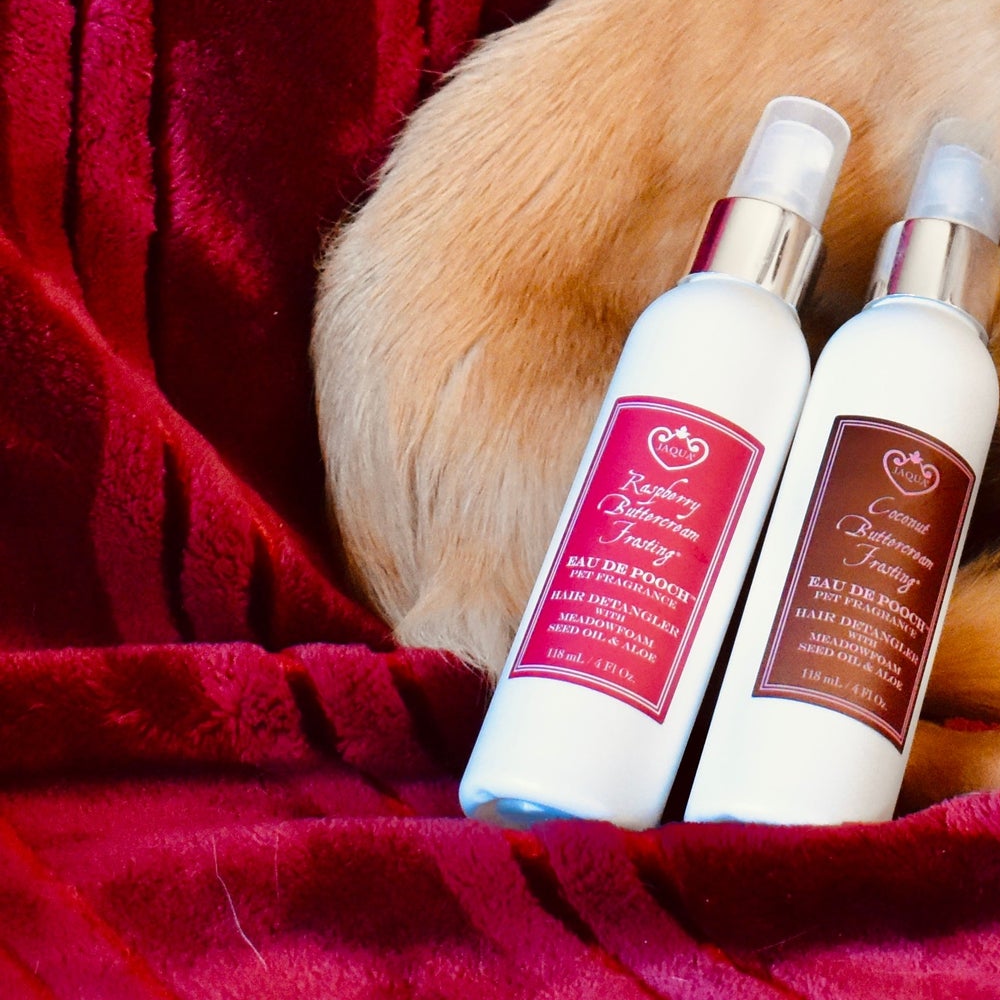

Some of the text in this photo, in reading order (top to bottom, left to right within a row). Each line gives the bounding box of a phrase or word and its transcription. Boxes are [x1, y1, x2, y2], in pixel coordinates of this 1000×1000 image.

[656, 443, 694, 460] JAQUA
[618, 469, 701, 519] Raspberry
[892, 466, 929, 488] JAQUA
[597, 493, 700, 542] Buttercream
[868, 496, 931, 535] Coconut
[836, 514, 934, 571] Buttercream
[566, 556, 601, 568] EAU
[601, 559, 628, 575] DE
[569, 569, 678, 610] PET FRAGRANCE
[808, 575, 847, 591] EAU
[849, 584, 875, 601] DE
[551, 590, 680, 638] HAIR DETANGLER
[558, 612, 654, 648] MEADOWFOAM
[595, 607, 626, 622] WITH
[814, 590, 918, 639] PET FRAGRANCE
[547, 623, 657, 663] SEED OIL & ALOE
[795, 607, 919, 666] HAIR DETANGLER
[809, 632, 902, 676] MEADOWFOAM
[848, 630, 878, 649] WITH
[547, 648, 565, 659] 118
[566, 653, 584, 664] mL
[594, 658, 602, 668] 4
[604, 662, 617, 674] Fl
[619, 667, 636, 683] Oz.
[798, 642, 903, 691] SEED OIL & ALOE
[801, 668, 822, 681] 118
[823, 674, 843, 688] mL
[851, 683, 860, 695] 4
[861, 687, 873, 700] Fl
